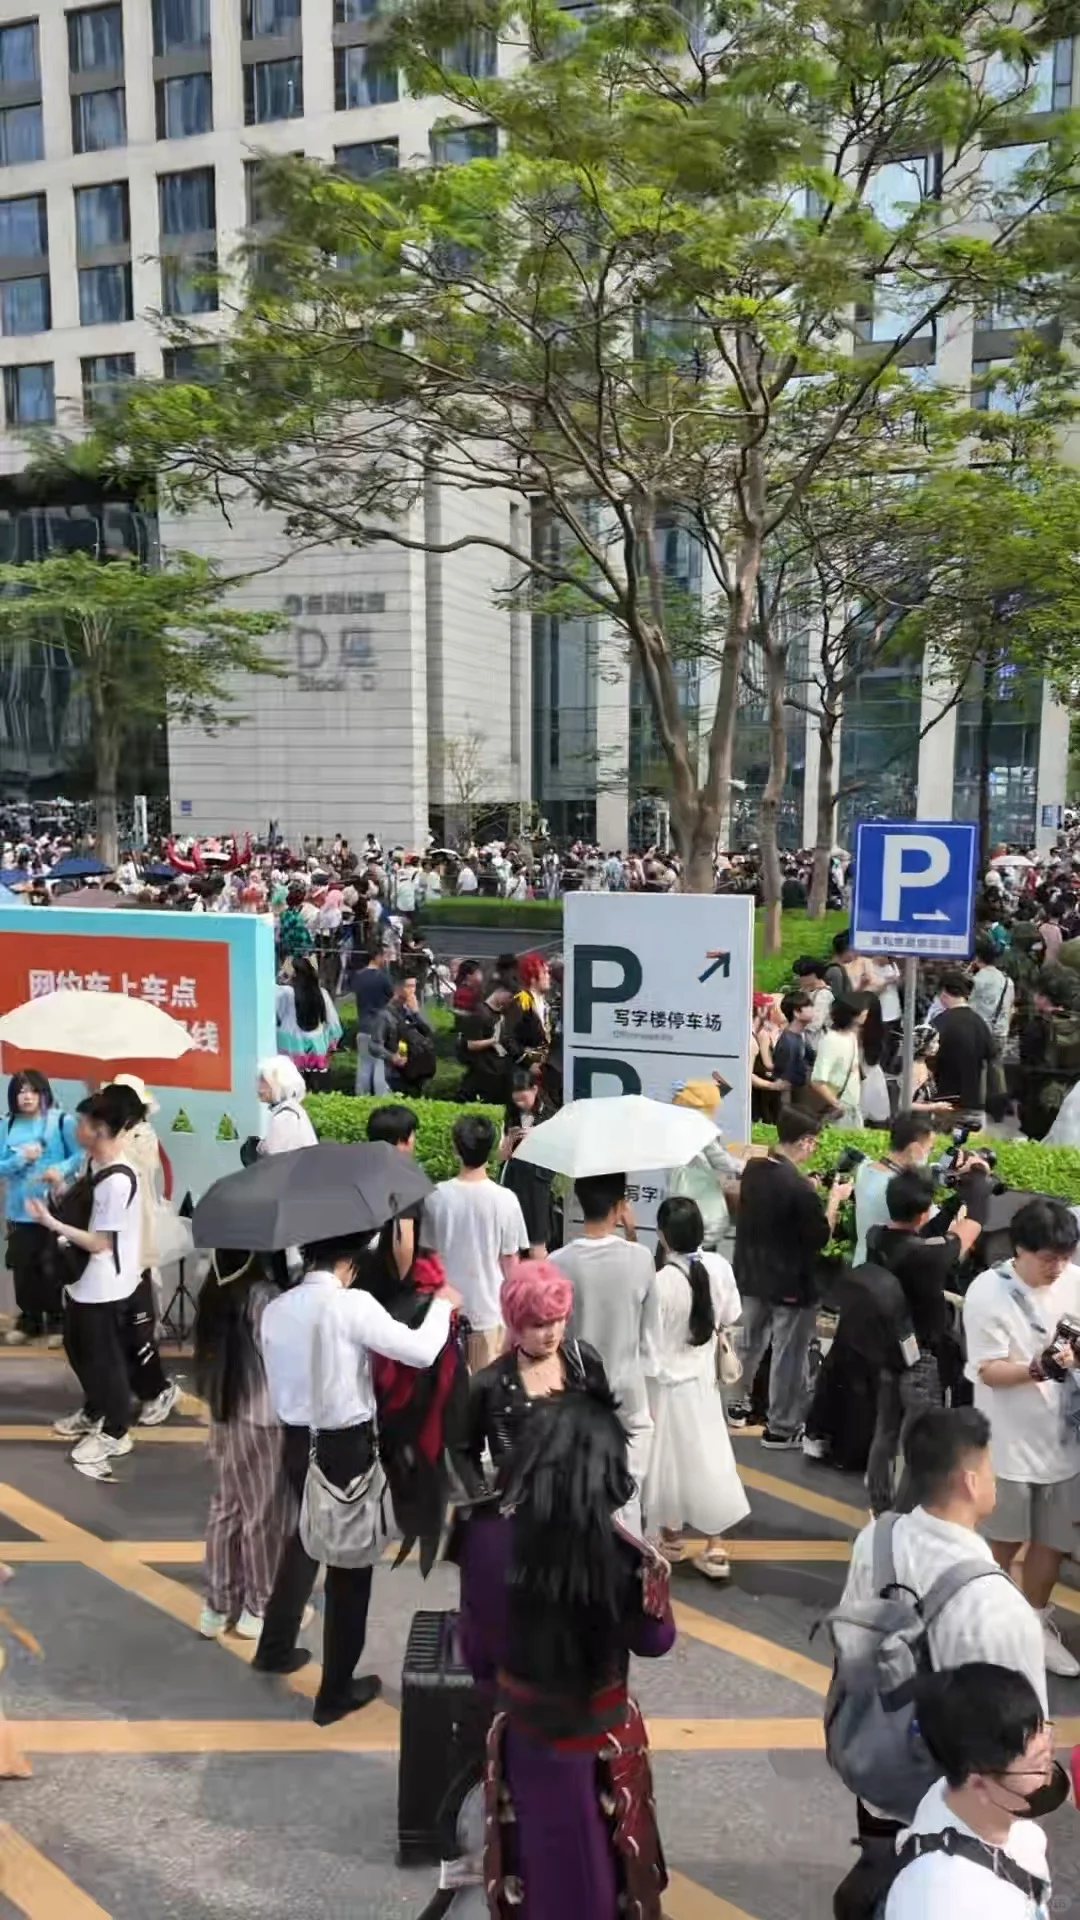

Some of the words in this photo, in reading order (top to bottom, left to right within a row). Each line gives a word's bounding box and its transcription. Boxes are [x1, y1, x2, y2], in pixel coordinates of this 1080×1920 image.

[881, 834, 950, 921] P
[573, 945, 643, 1034] P
[613, 1009, 722, 1032] 写字楼停车场
